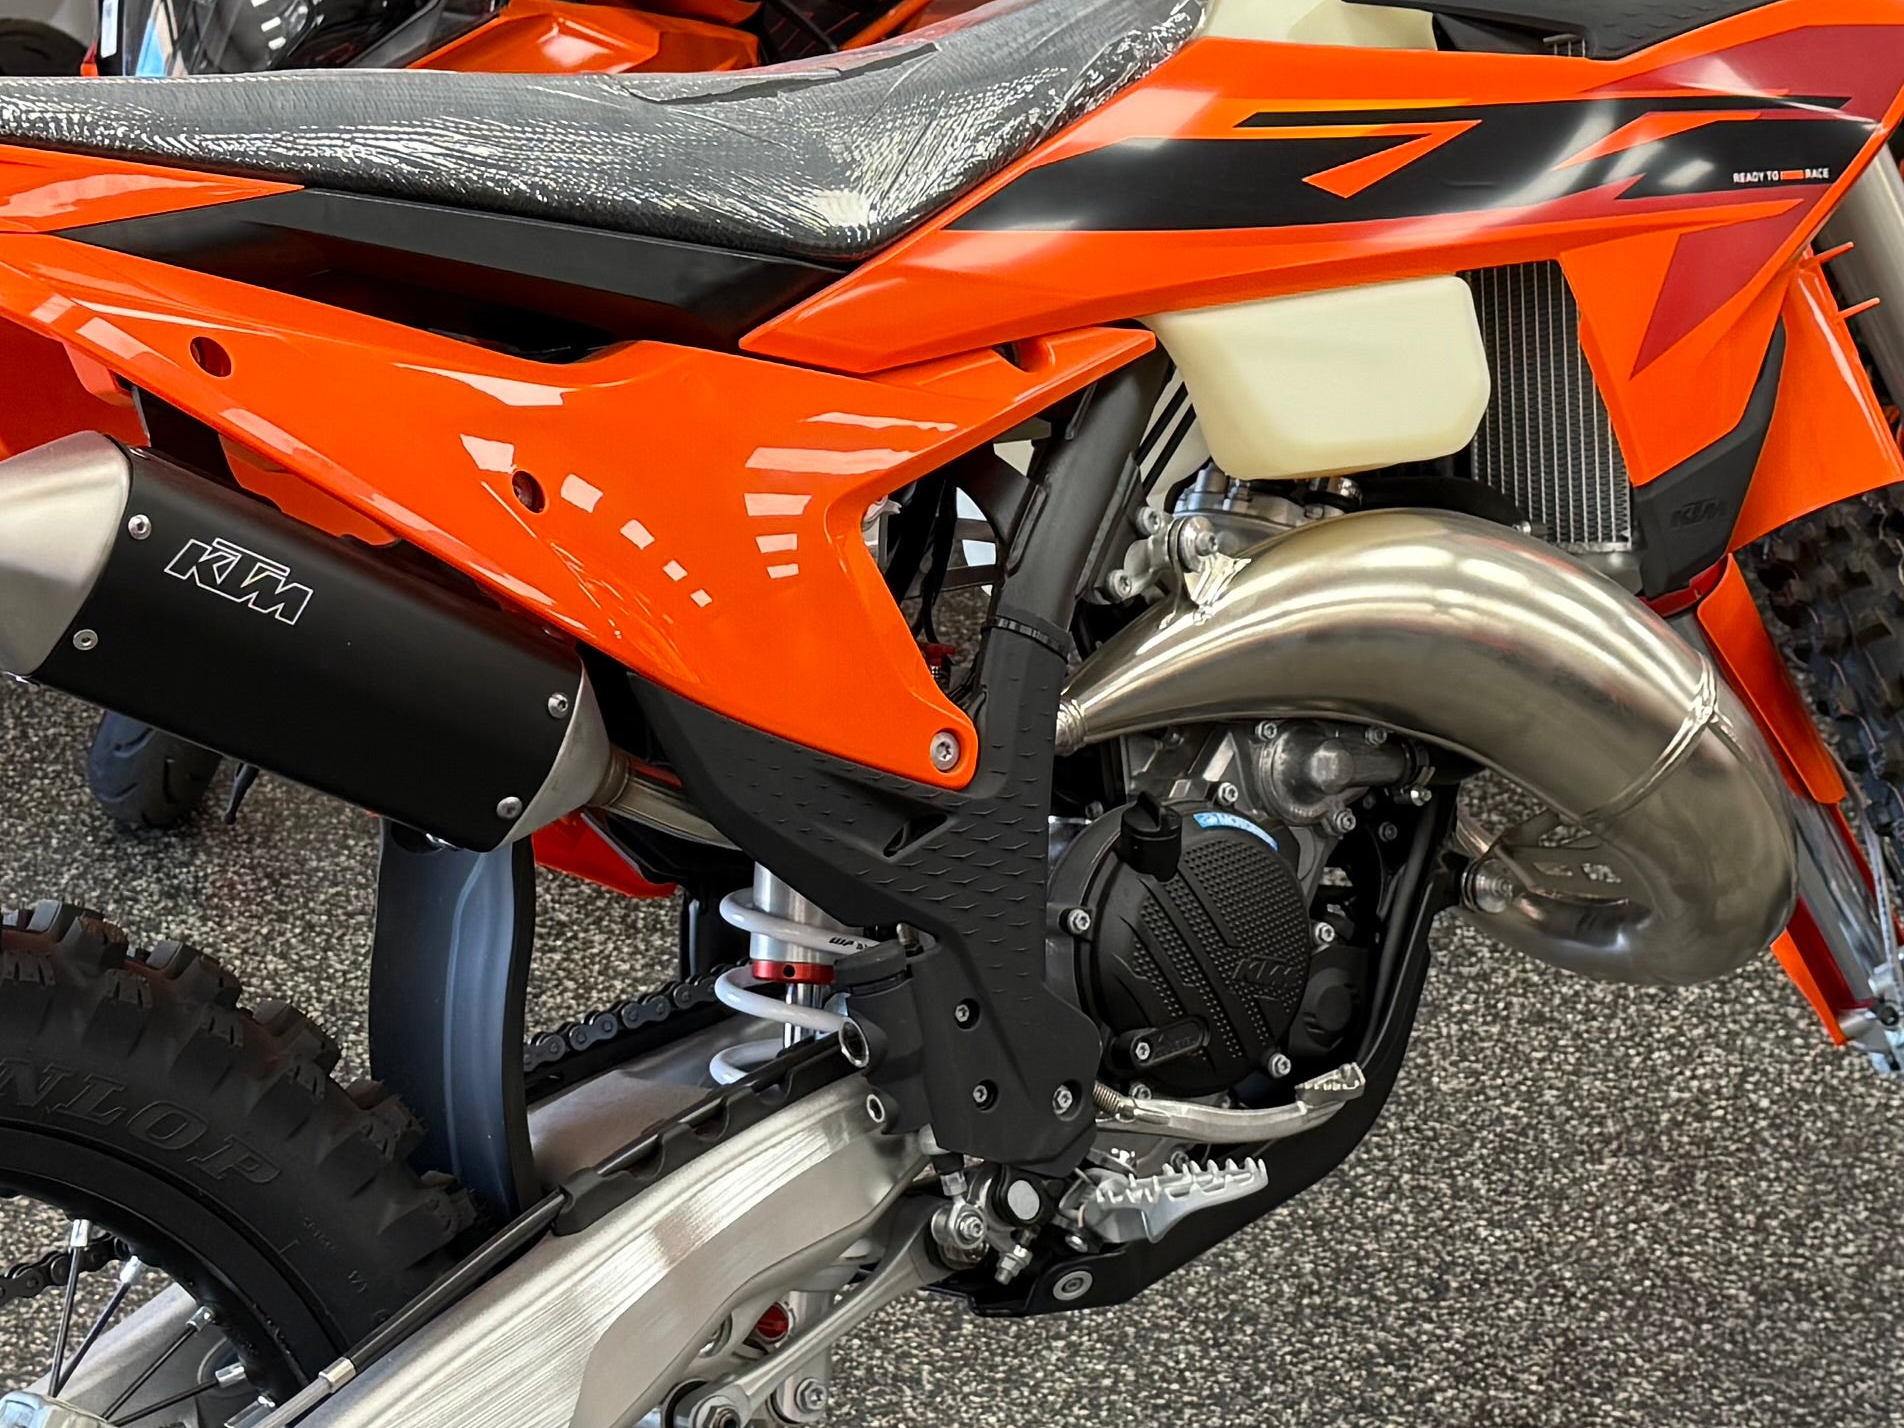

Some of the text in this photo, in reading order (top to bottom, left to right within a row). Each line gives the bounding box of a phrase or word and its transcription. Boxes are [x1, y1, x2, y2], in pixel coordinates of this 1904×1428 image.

[1732, 172, 1765, 183] READY
[1766, 170, 1779, 181] TO
[163, 537, 314, 626] KTM
